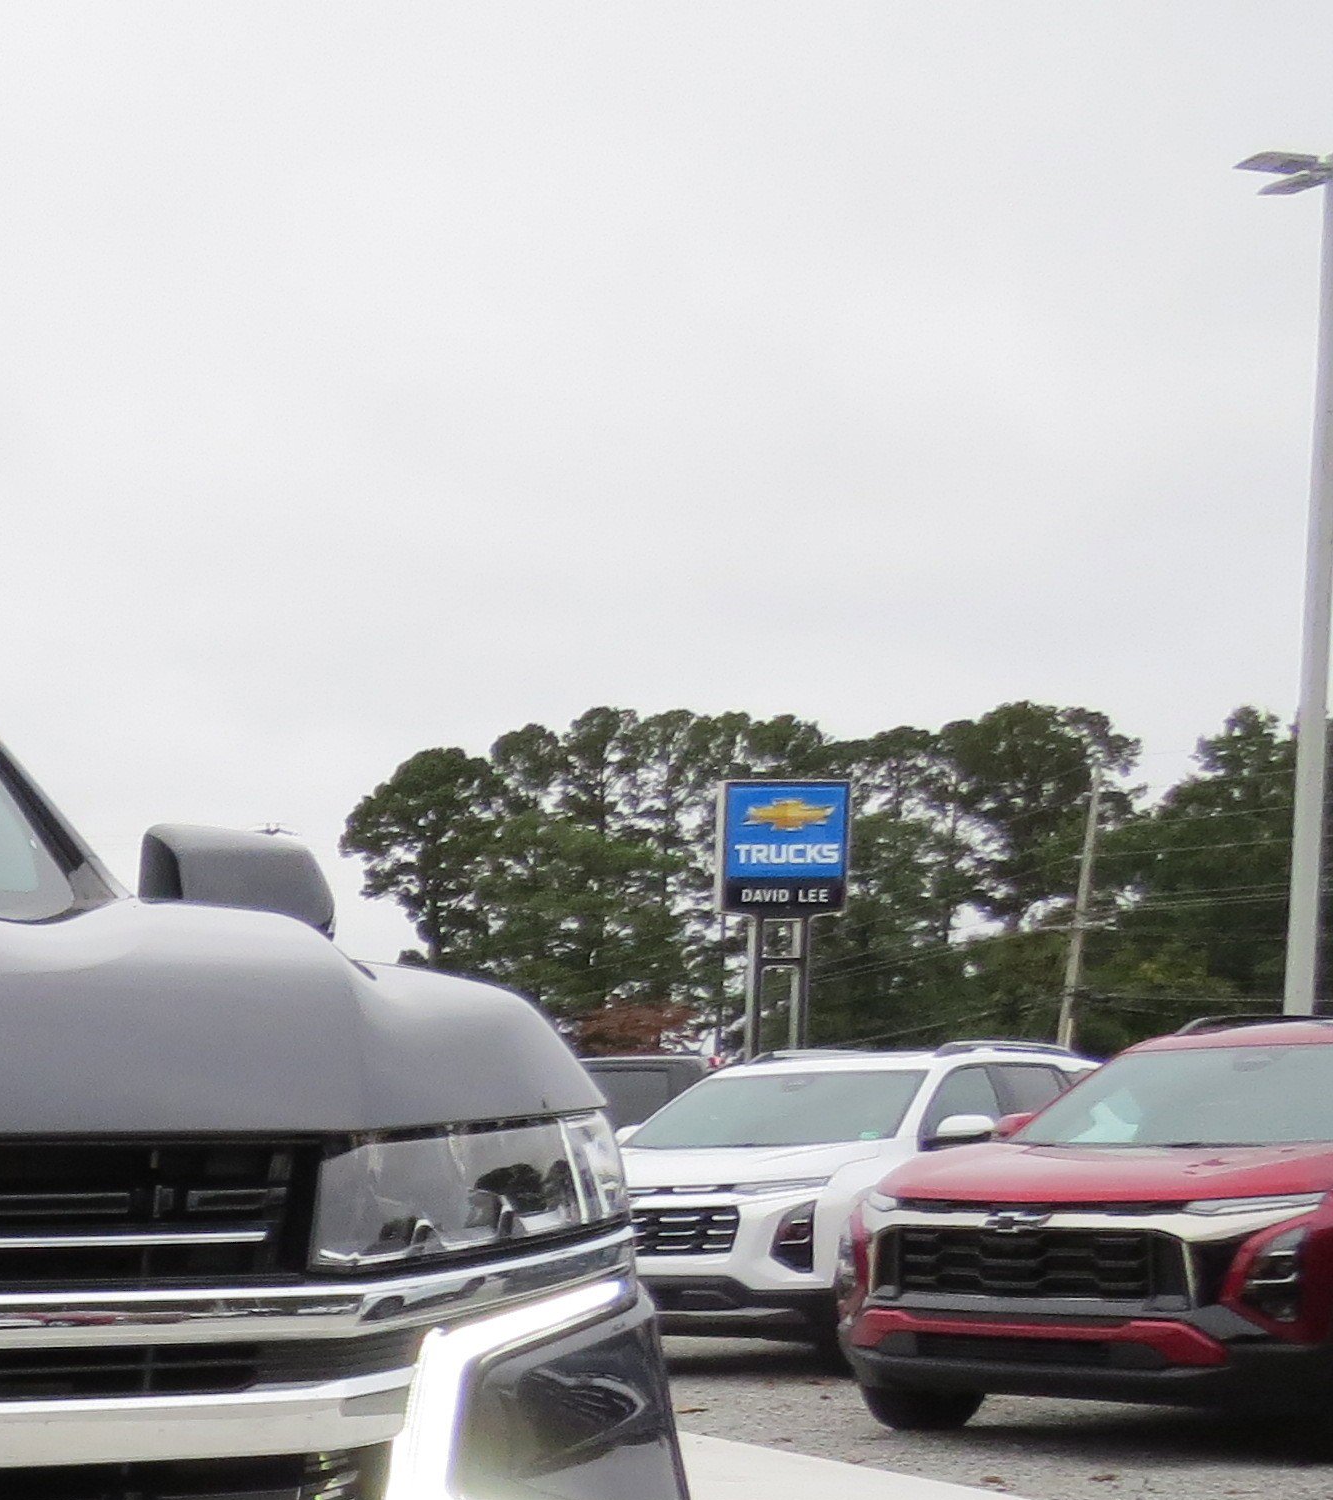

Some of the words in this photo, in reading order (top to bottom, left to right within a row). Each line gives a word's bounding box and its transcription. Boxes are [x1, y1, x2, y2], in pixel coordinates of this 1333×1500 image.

[735, 843, 840, 864] TRUCKS
[741, 888, 790, 903] DAVID
[798, 888, 830, 903] LEE
